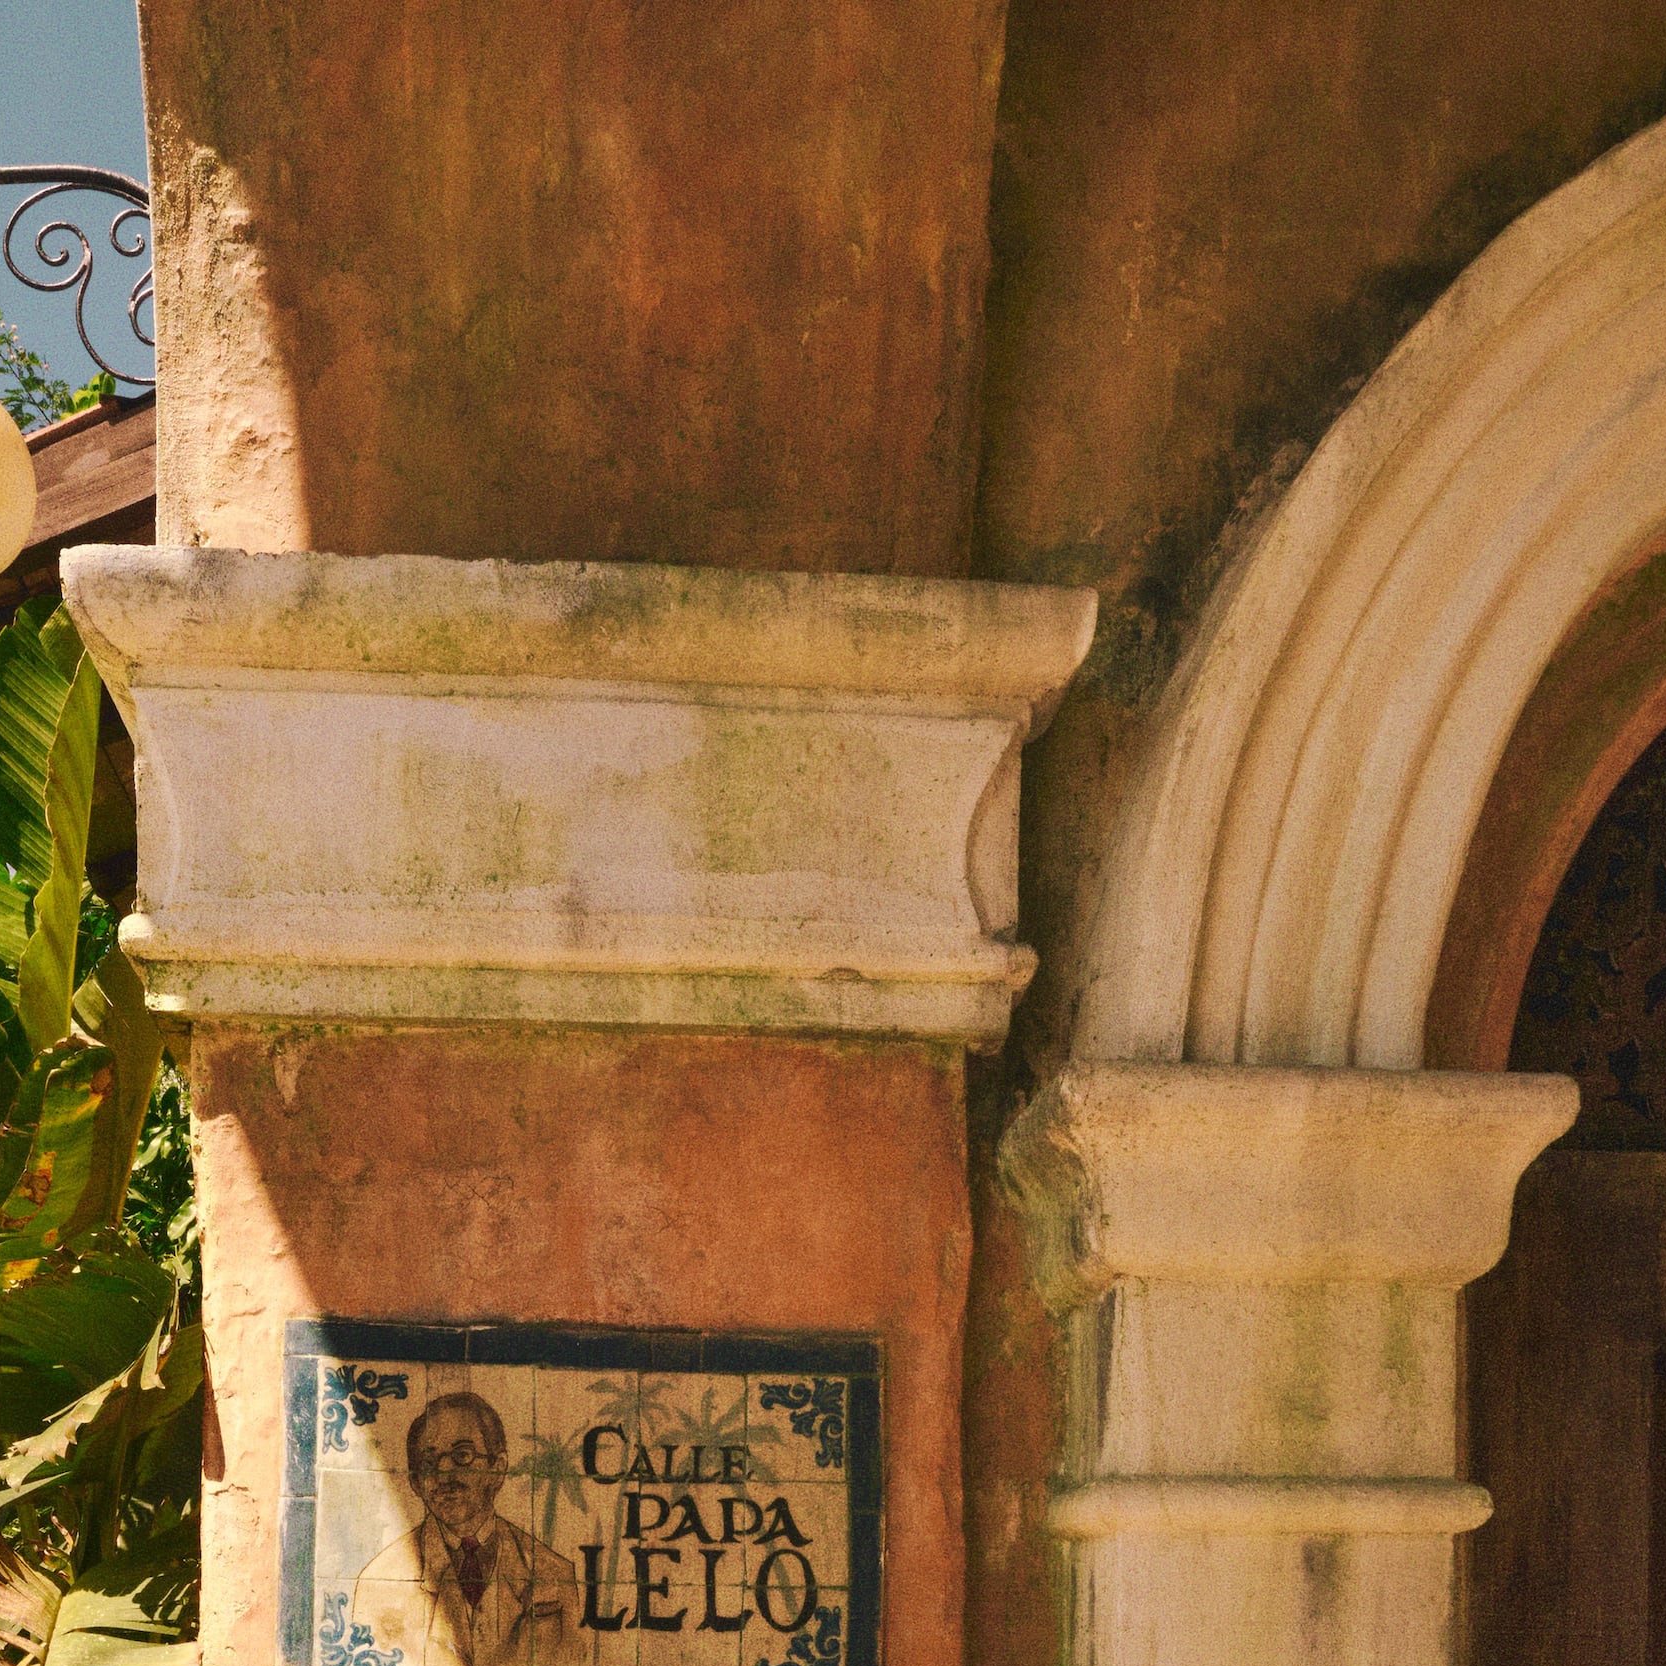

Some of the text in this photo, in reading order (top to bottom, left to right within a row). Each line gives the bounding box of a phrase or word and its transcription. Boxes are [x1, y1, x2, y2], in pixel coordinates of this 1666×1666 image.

[583, 1423, 752, 1484] CALLE
[622, 1492, 813, 1547] PAPA
[578, 1545, 818, 1633] LELO
